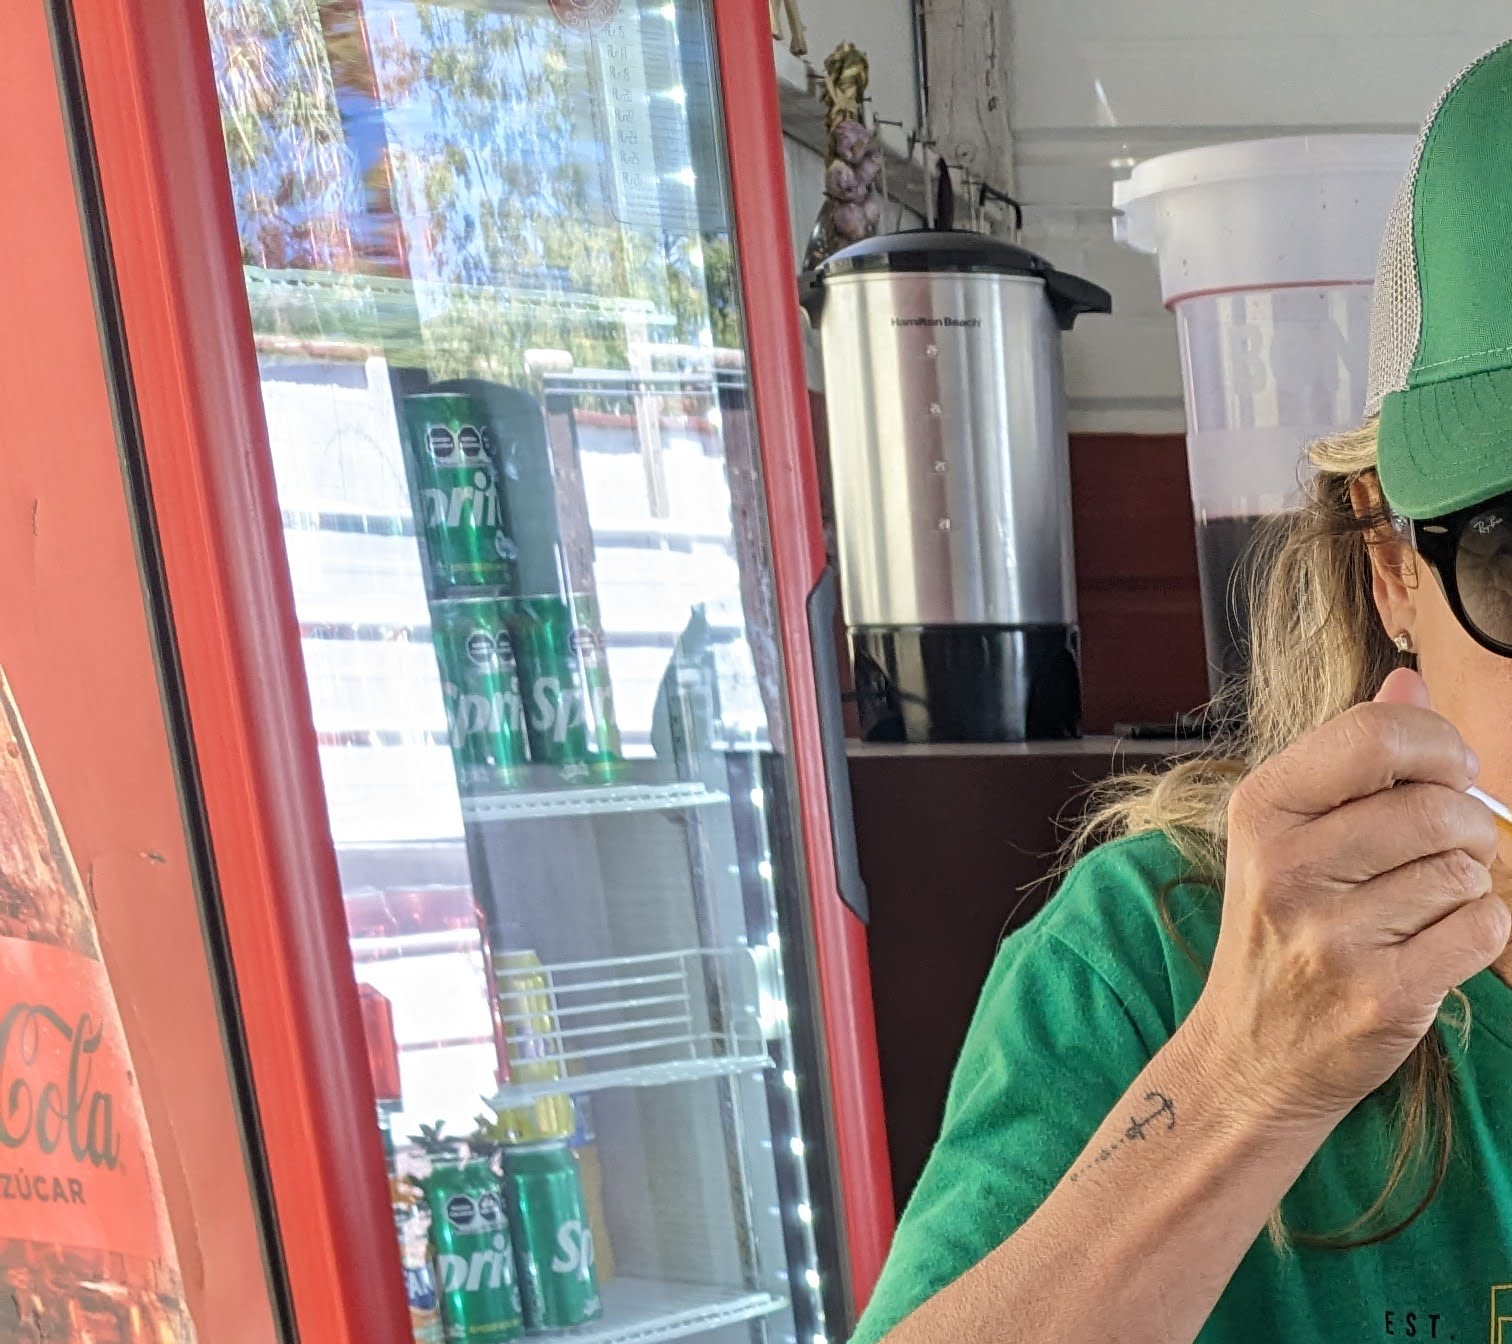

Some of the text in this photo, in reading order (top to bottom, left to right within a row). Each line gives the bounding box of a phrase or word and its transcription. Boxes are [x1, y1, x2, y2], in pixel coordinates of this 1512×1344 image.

[891, 317, 981, 327] Hamilton Beach
[1385, 1310, 1454, 1340] EST.
